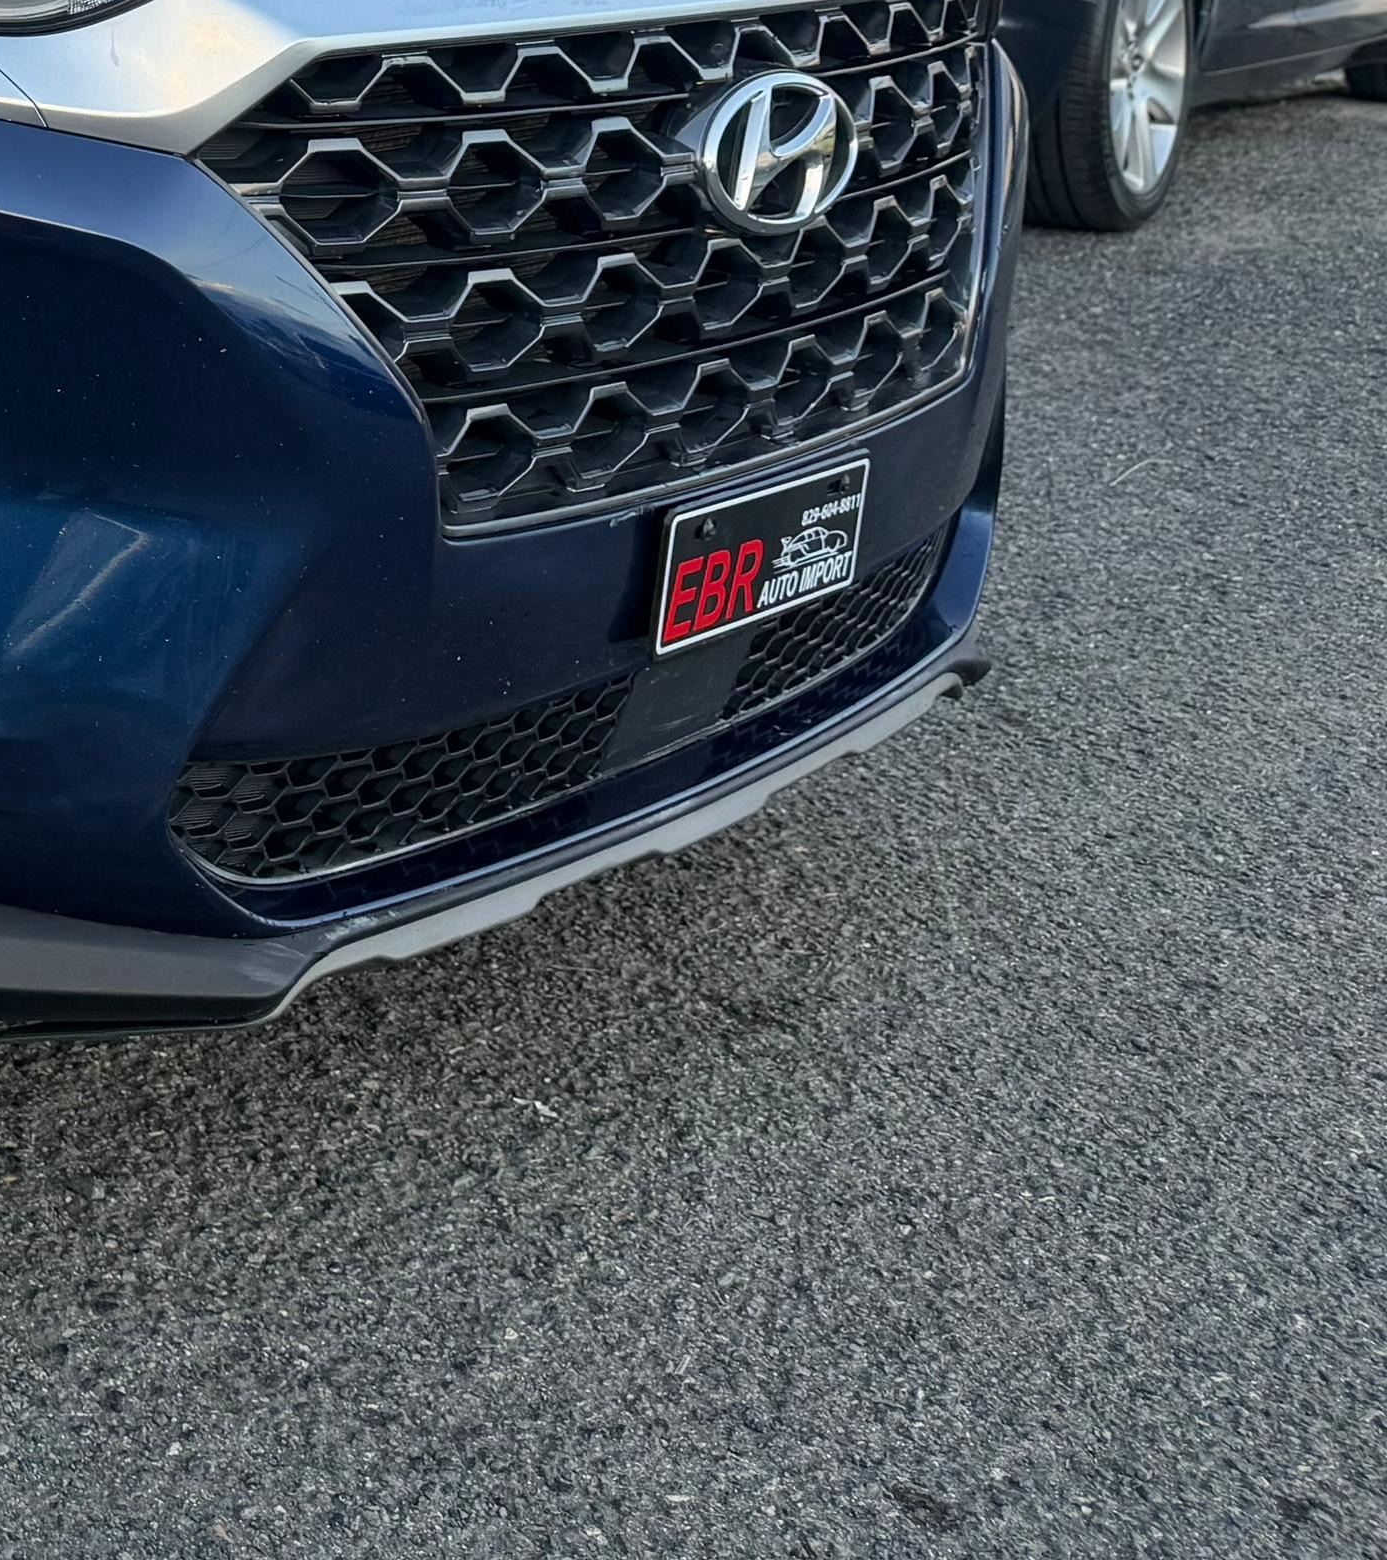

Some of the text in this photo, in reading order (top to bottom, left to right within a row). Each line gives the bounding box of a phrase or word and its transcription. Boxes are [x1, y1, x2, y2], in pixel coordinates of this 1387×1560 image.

[663, 538, 764, 643] EBR
[756, 550, 854, 609] AUTO IMPORT
